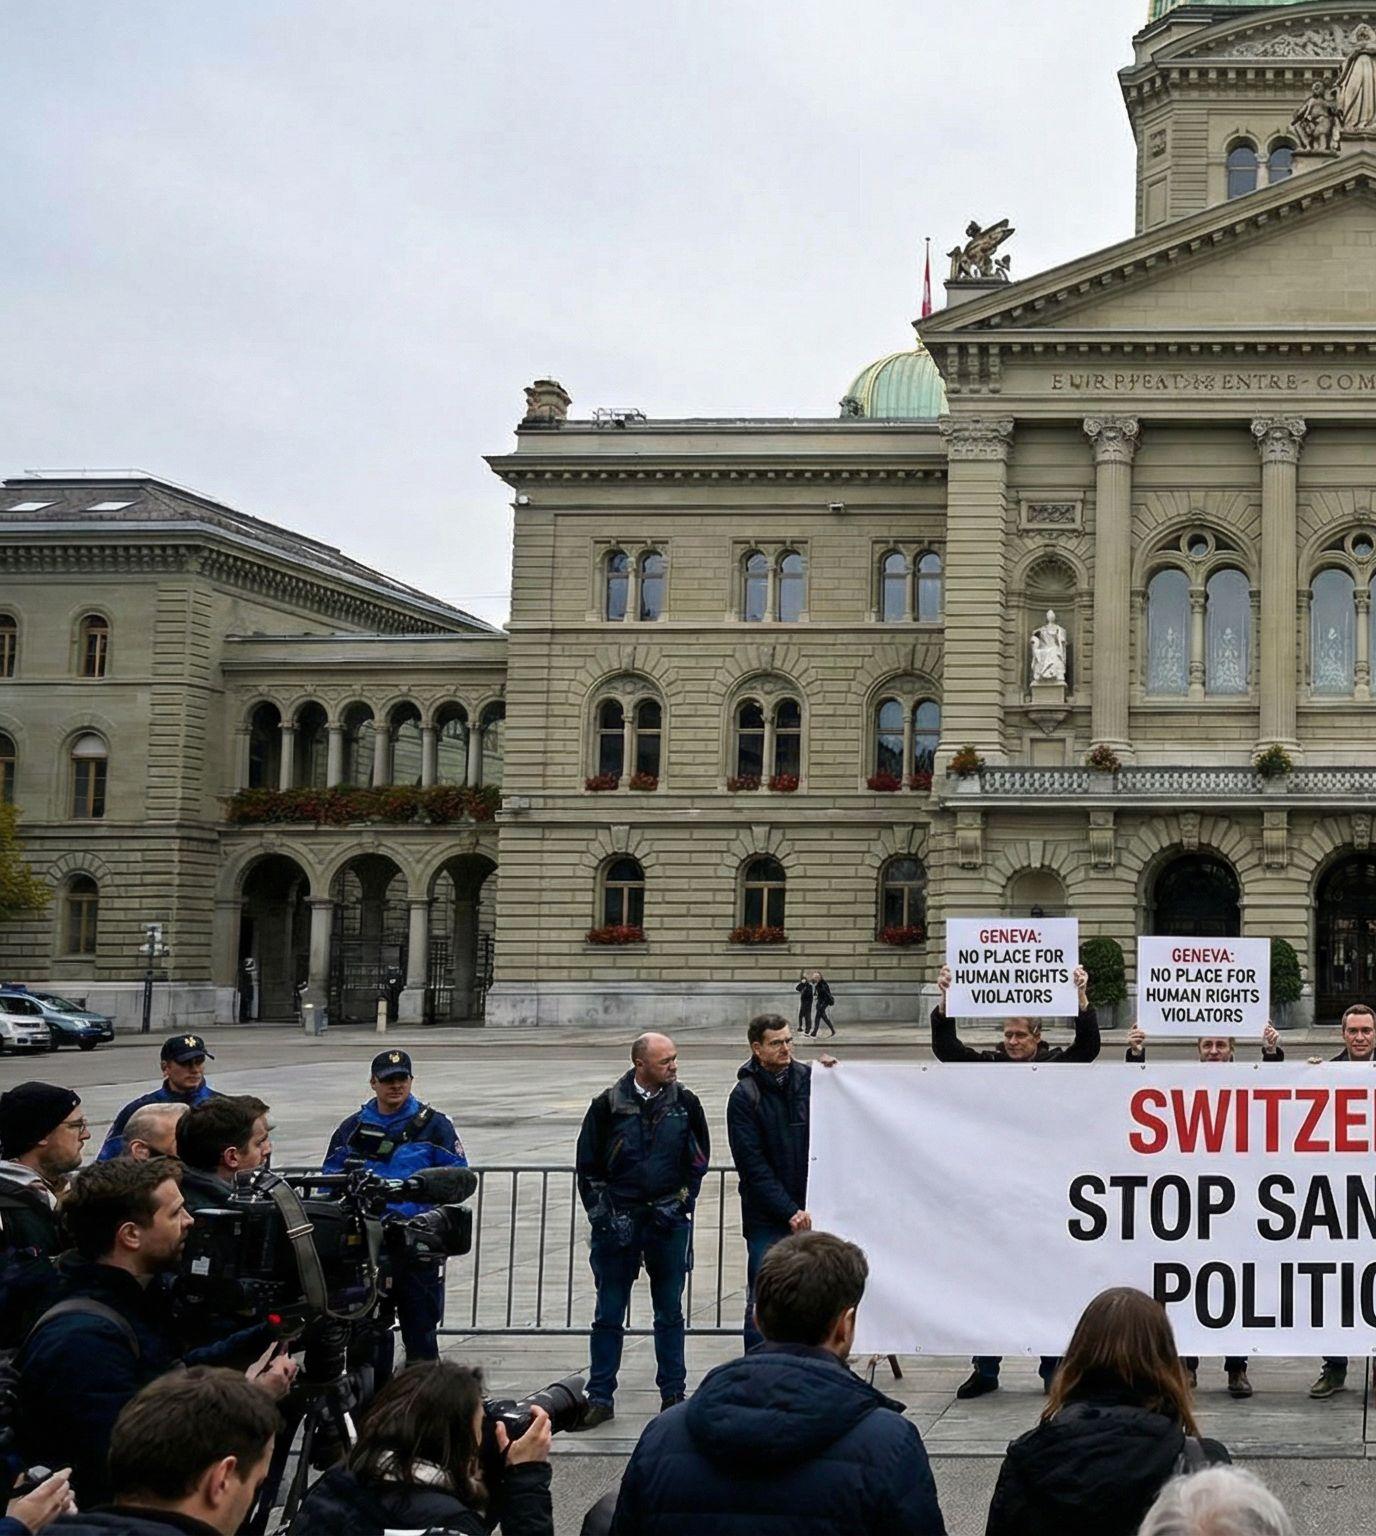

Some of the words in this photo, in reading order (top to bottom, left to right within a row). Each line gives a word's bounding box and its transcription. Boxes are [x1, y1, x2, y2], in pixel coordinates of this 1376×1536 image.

[979, 928, 1042, 944] GENEVA:
[959, 949, 979, 964] NO
[984, 949, 1031, 964] PLACE
[1036, 948, 1064, 964] FOR
[1171, 947, 1235, 964] GENEVA:
[955, 968, 1010, 984] HUMAN
[1015, 968, 1069, 984] RIGHTS
[1150, 967, 1171, 983] NO
[1176, 967, 1222, 983] PLACE
[1227, 968, 1256, 984] FOR
[971, 988, 1053, 1004] VIOLATORS
[1146, 987, 1201, 1003] HUMAN
[1205, 988, 1260, 1004] RIGHTS
[1161, 1007, 1243, 1023] VIOLATORS
[1068, 1174, 1236, 1242] STOP
